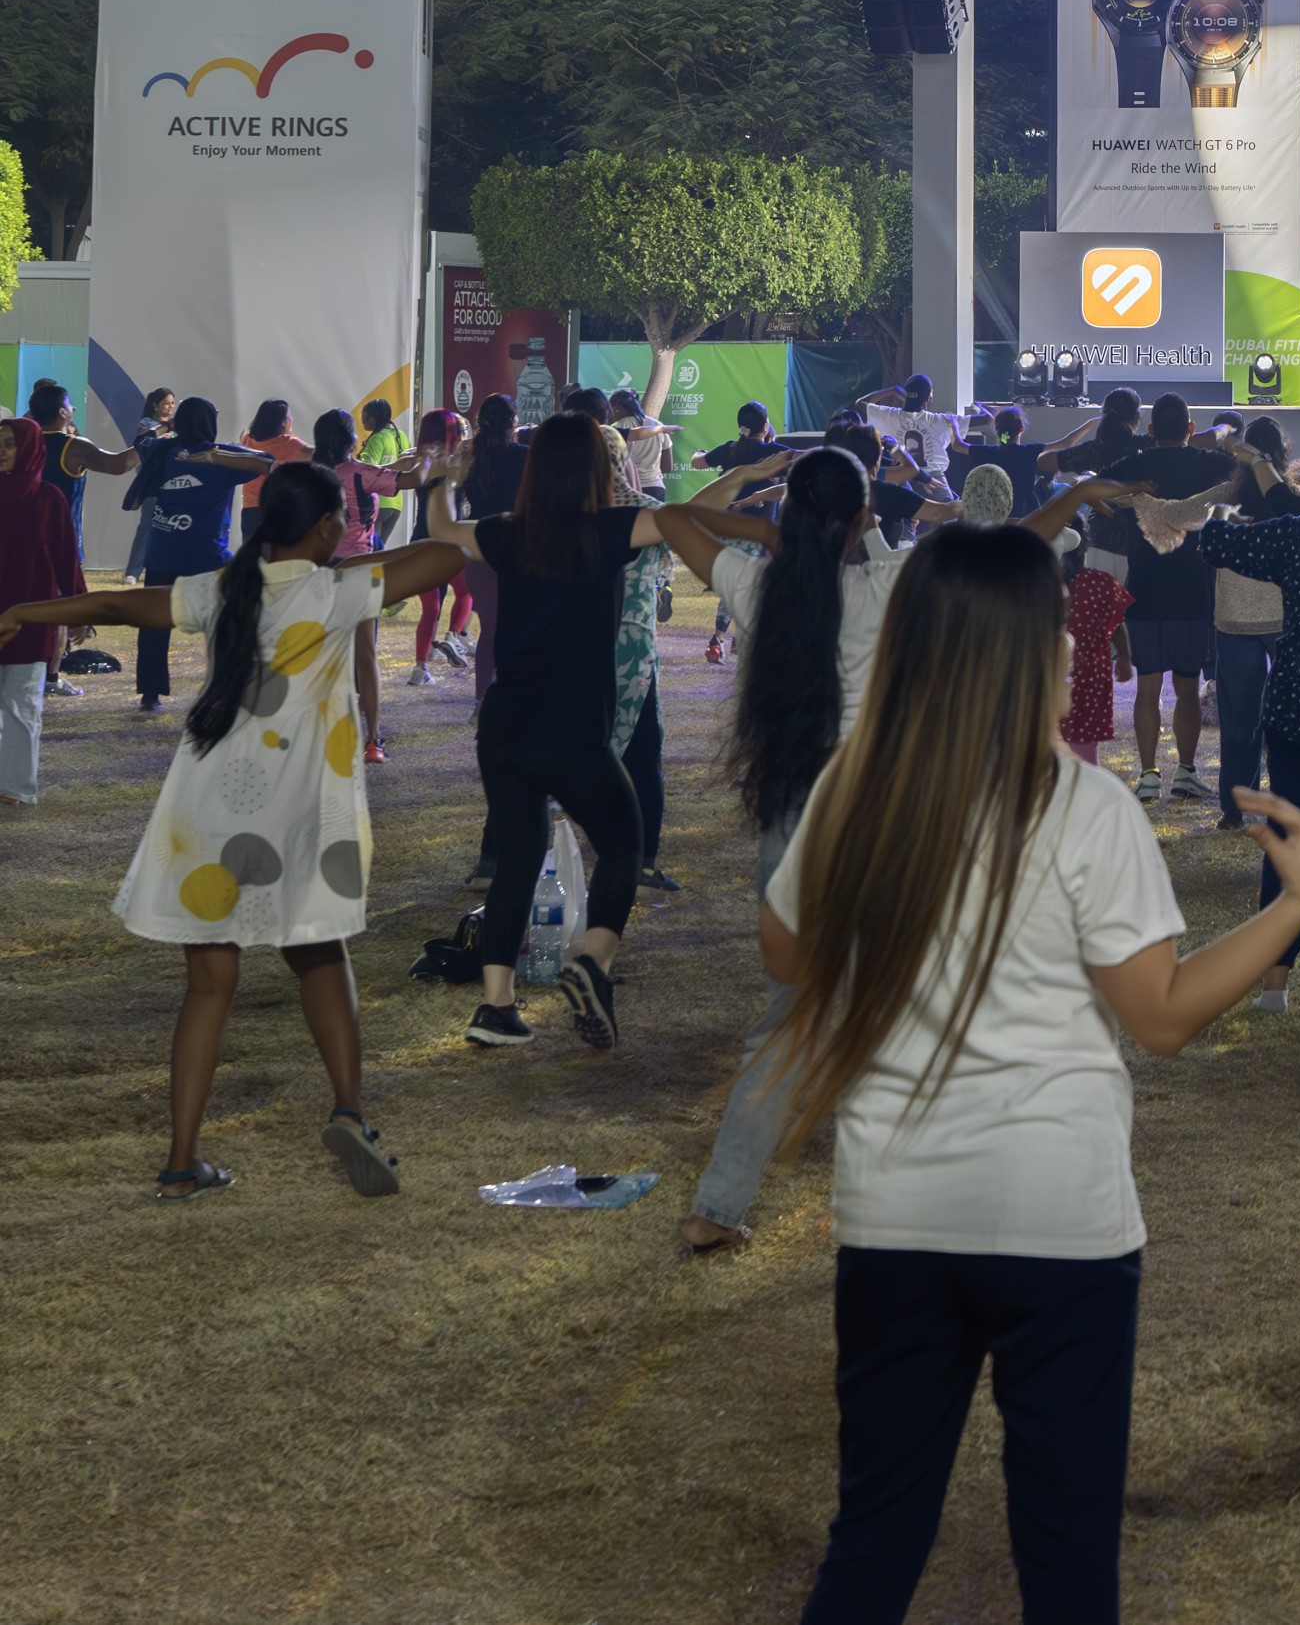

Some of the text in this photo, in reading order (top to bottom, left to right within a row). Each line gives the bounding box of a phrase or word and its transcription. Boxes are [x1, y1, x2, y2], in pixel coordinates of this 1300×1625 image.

[1193, 17, 1238, 26] 10:08
[167, 116, 348, 137] ACTIVE RINGS
[1092, 140, 1256, 151] HUAWEI WATCH GT 6 Pro
[192, 145, 321, 159] Enjoy Your Moment
[1131, 163, 1216, 174] Ride the Wind
[454, 280, 464, 288] CAP
[468, 281, 485, 289] BOTTLE
[454, 309, 503, 325] FOR GOOD
[1225, 339, 1271, 351] DUBAI
[1136, 343, 1213, 365] Health
[667, 394, 704, 403] FITNESS
[170, 478, 192, 487] RTA
